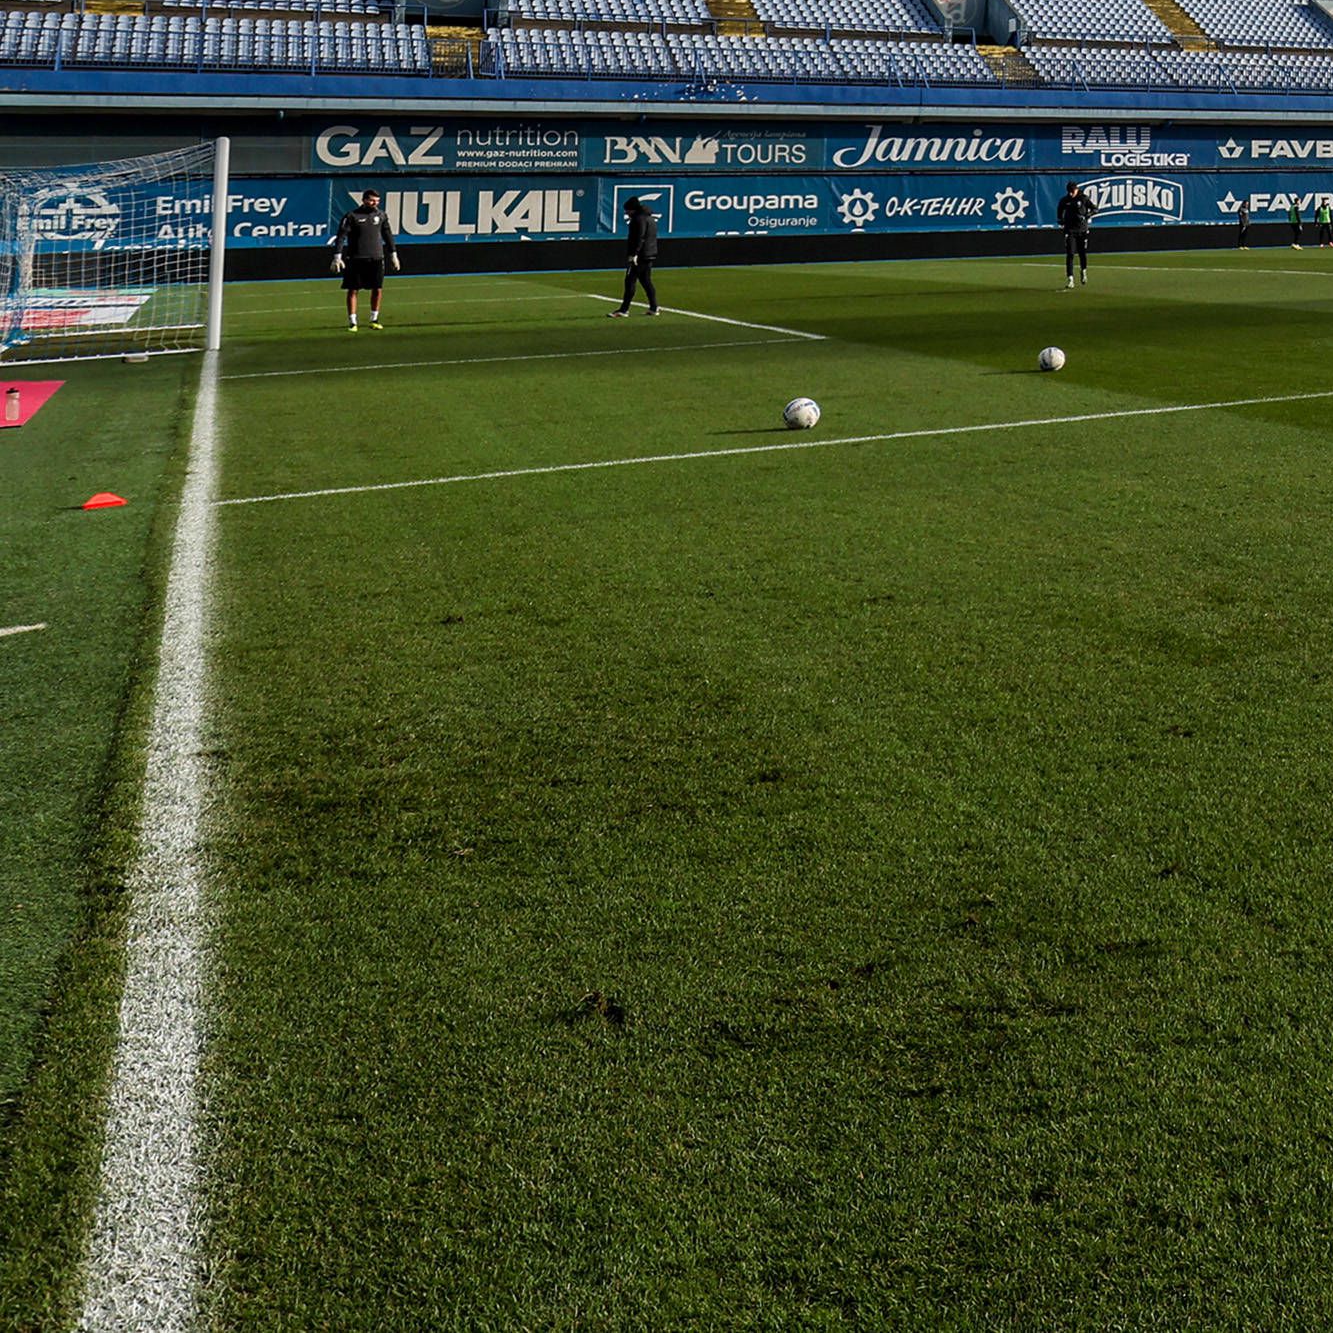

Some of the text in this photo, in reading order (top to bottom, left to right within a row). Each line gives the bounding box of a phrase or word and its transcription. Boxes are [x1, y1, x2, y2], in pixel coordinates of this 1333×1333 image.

[316, 123, 579, 166] GAZ nutrition
[833, 124, 1026, 168] Jamnica
[1062, 126, 1150, 153] RALU
[456, 149, 578, 159] www.gaz-nutrition.com
[534, 160, 578, 168] PREHRANI
[722, 144, 806, 164] TOURS
[227, 195, 287, 217] Frey
[684, 190, 818, 214] Groupama
[72, 216, 119, 232] Frey
[234, 221, 327, 237] Centar
[747, 216, 818, 228] Osiguranje
